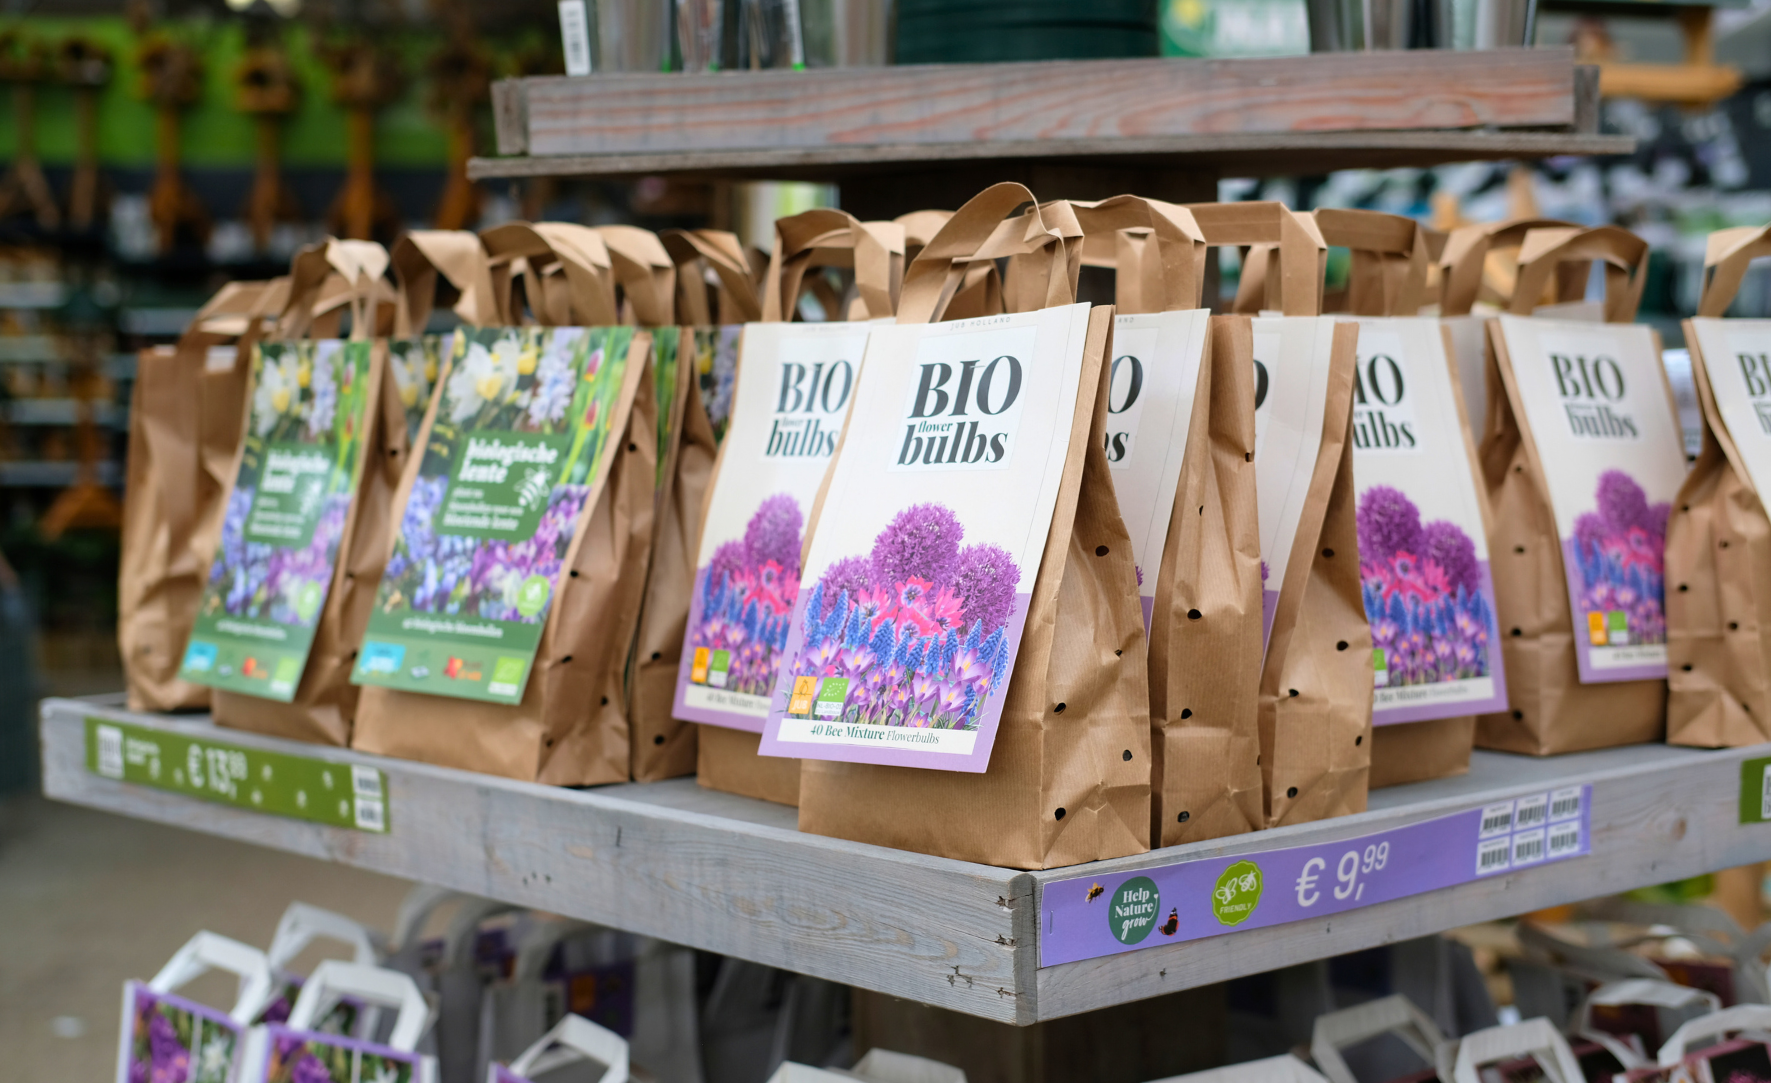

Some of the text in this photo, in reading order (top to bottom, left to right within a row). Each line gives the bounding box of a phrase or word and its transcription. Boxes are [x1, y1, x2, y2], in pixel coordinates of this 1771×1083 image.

[950, 316, 1011, 330] JUB HOLLAND
[776, 359, 853, 414] BIO
[907, 355, 1022, 418] BIO
[1355, 353, 1404, 408] IO
[1548, 353, 1625, 402] BIO
[765, 418, 839, 457] bulbs
[918, 420, 953, 433] flower
[1353, 410, 1416, 449] ulbs
[1563, 403, 1639, 439] bulbs
[897, 420, 1008, 465] bulbs
[791, 699, 808, 711] JUB
[810, 724, 940, 744] 40 Bee Mixture Flowerbulbs
[1295, 841, 1390, 907] € 9,99
[1114, 901, 1154, 918] Nature
[1123, 887, 1150, 903] Help
[1219, 902, 1252, 914] FRIENDLY
[1121, 917, 1149, 940] grow
